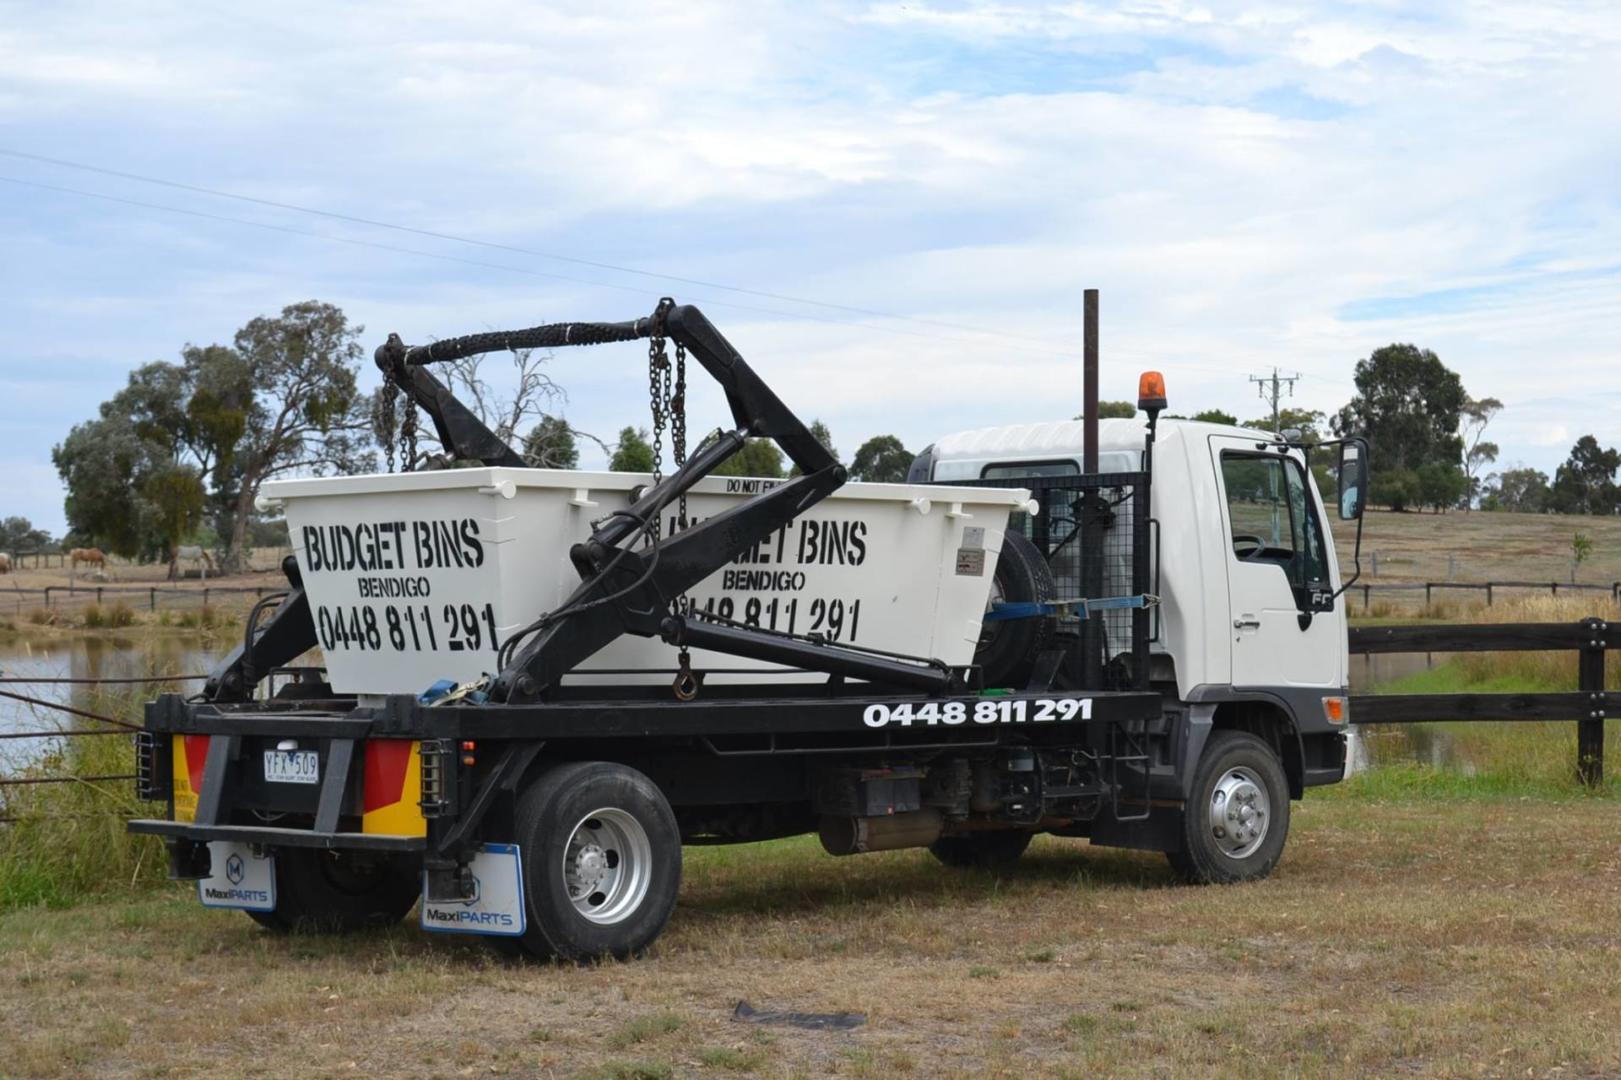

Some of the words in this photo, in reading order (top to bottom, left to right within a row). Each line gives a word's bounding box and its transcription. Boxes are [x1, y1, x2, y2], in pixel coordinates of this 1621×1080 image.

[727, 479, 741, 493] DO
[742, 480, 760, 493] NOT
[303, 521, 406, 572] BUDGET
[412, 518, 484, 568] BINS
[798, 520, 867, 566] BINS
[358, 576, 431, 598] BENDIGO
[722, 570, 806, 591] BENDIGO
[318, 605, 381, 651] 0448
[385, 605, 438, 651] 811
[443, 603, 499, 652] 291
[809, 597, 861, 642] 291
[863, 702, 967, 728] 0448
[973, 700, 1027, 723] 811
[1033, 698, 1093, 721] 291
[205, 888, 268, 902] MaxiPARTS
[427, 908, 513, 926] MaxiPARTS
